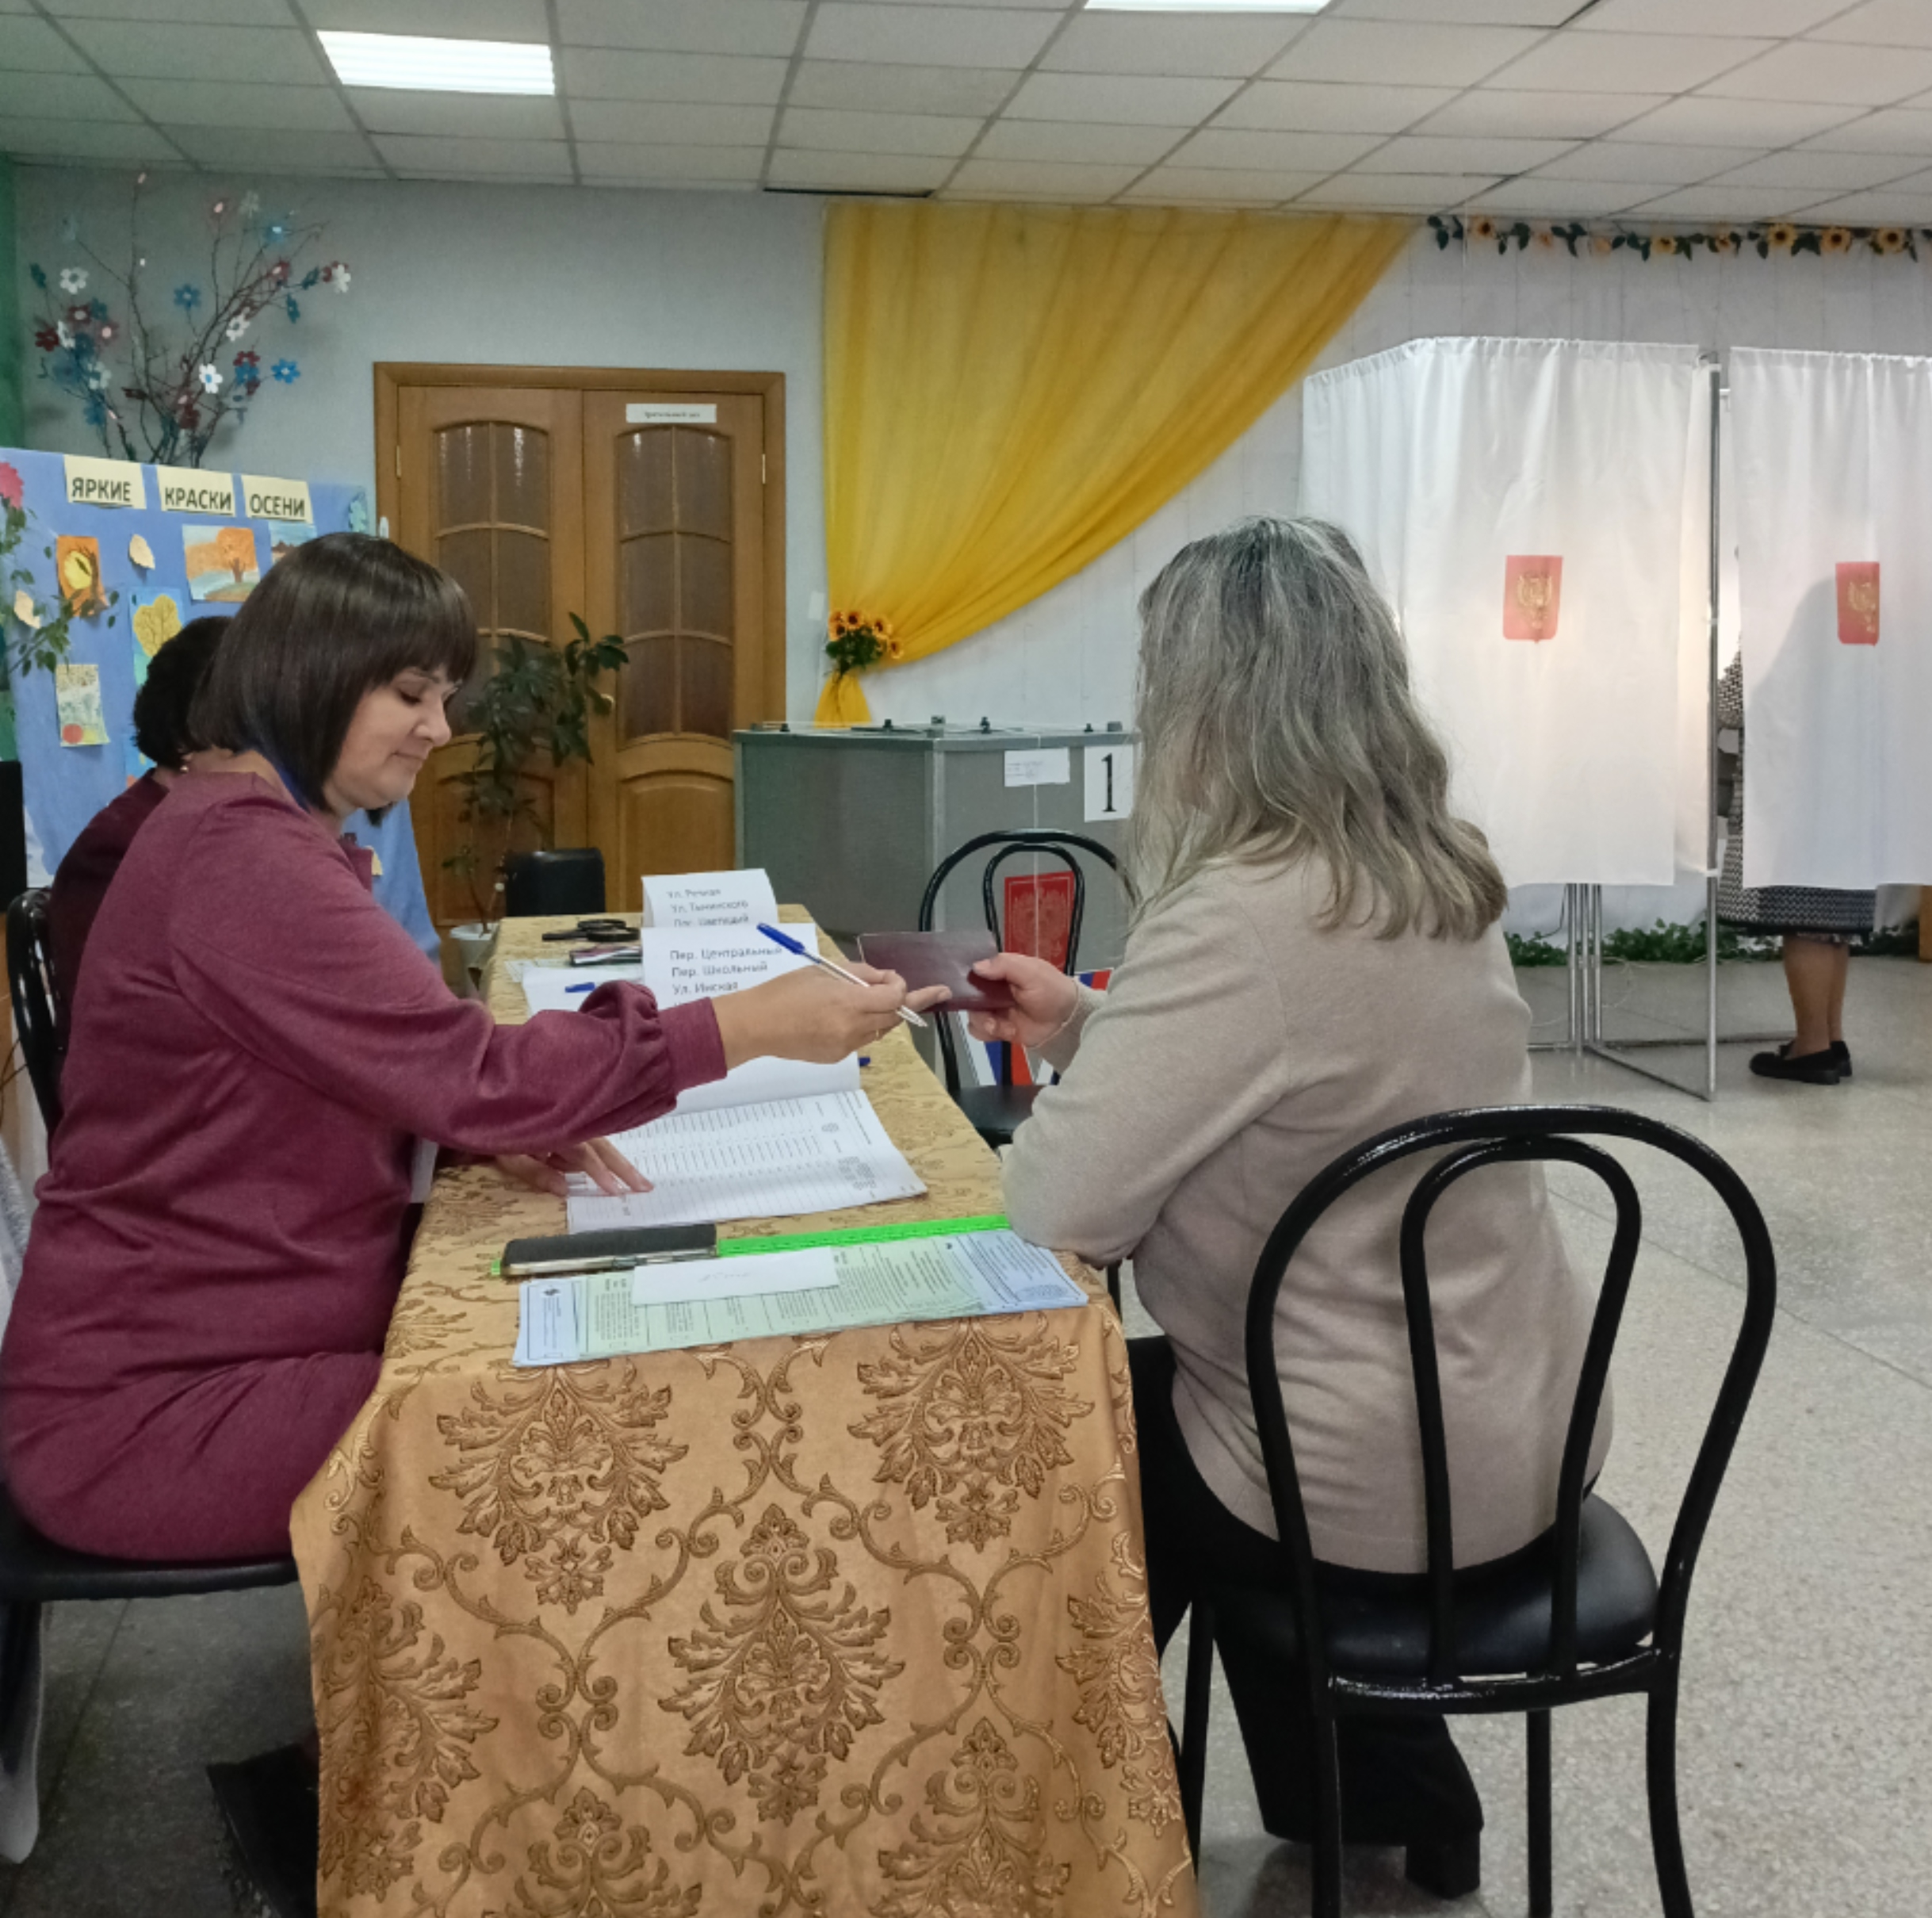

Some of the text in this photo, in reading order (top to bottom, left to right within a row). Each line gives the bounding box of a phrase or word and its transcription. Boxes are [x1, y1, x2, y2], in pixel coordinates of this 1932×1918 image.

[72, 477, 306, 517] ЯРКИЕ КРАСКИ ОСЕНИ
[1101, 752, 1117, 813] 1
[670, 946, 782, 962] Пер. Центральный
[671, 961, 768, 979] Пер. Школьный
